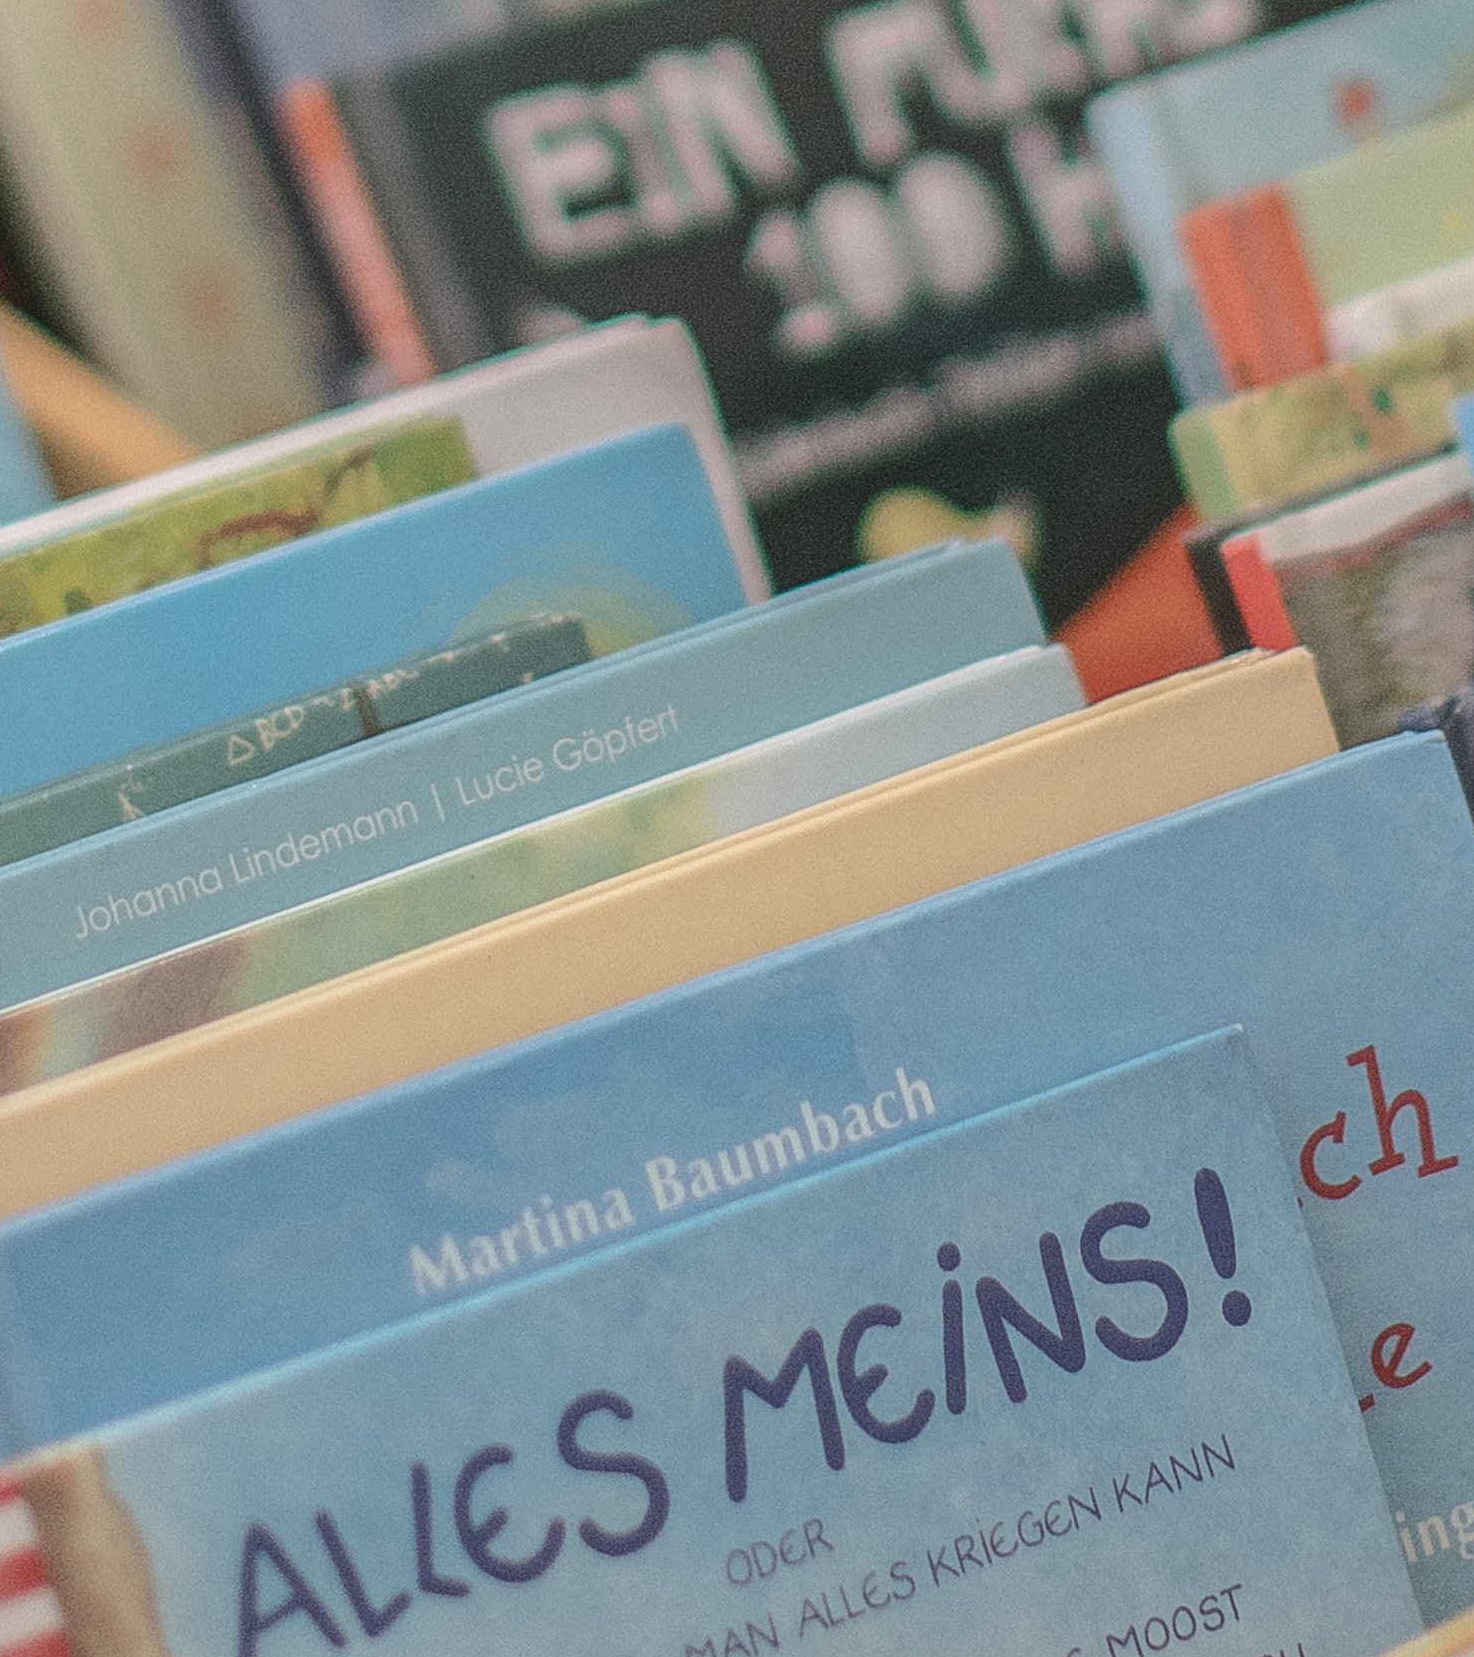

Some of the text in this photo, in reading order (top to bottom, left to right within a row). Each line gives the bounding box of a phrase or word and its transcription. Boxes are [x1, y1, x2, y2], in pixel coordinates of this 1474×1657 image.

[485, 38, 797, 263] EIN
[73, 863, 225, 941] Johanna
[227, 797, 421, 885] Lindemann
[452, 751, 546, 807] Lucie
[551, 702, 682, 771] Göpfert
[408, 1066, 937, 1297] Martina Baumbach
[1298, 1043, 1459, 1207] ch
[726, 1520, 836, 1589] ODER
[798, 1561, 917, 1641] ALLES
[1113, 1433, 1237, 1514] KANN
